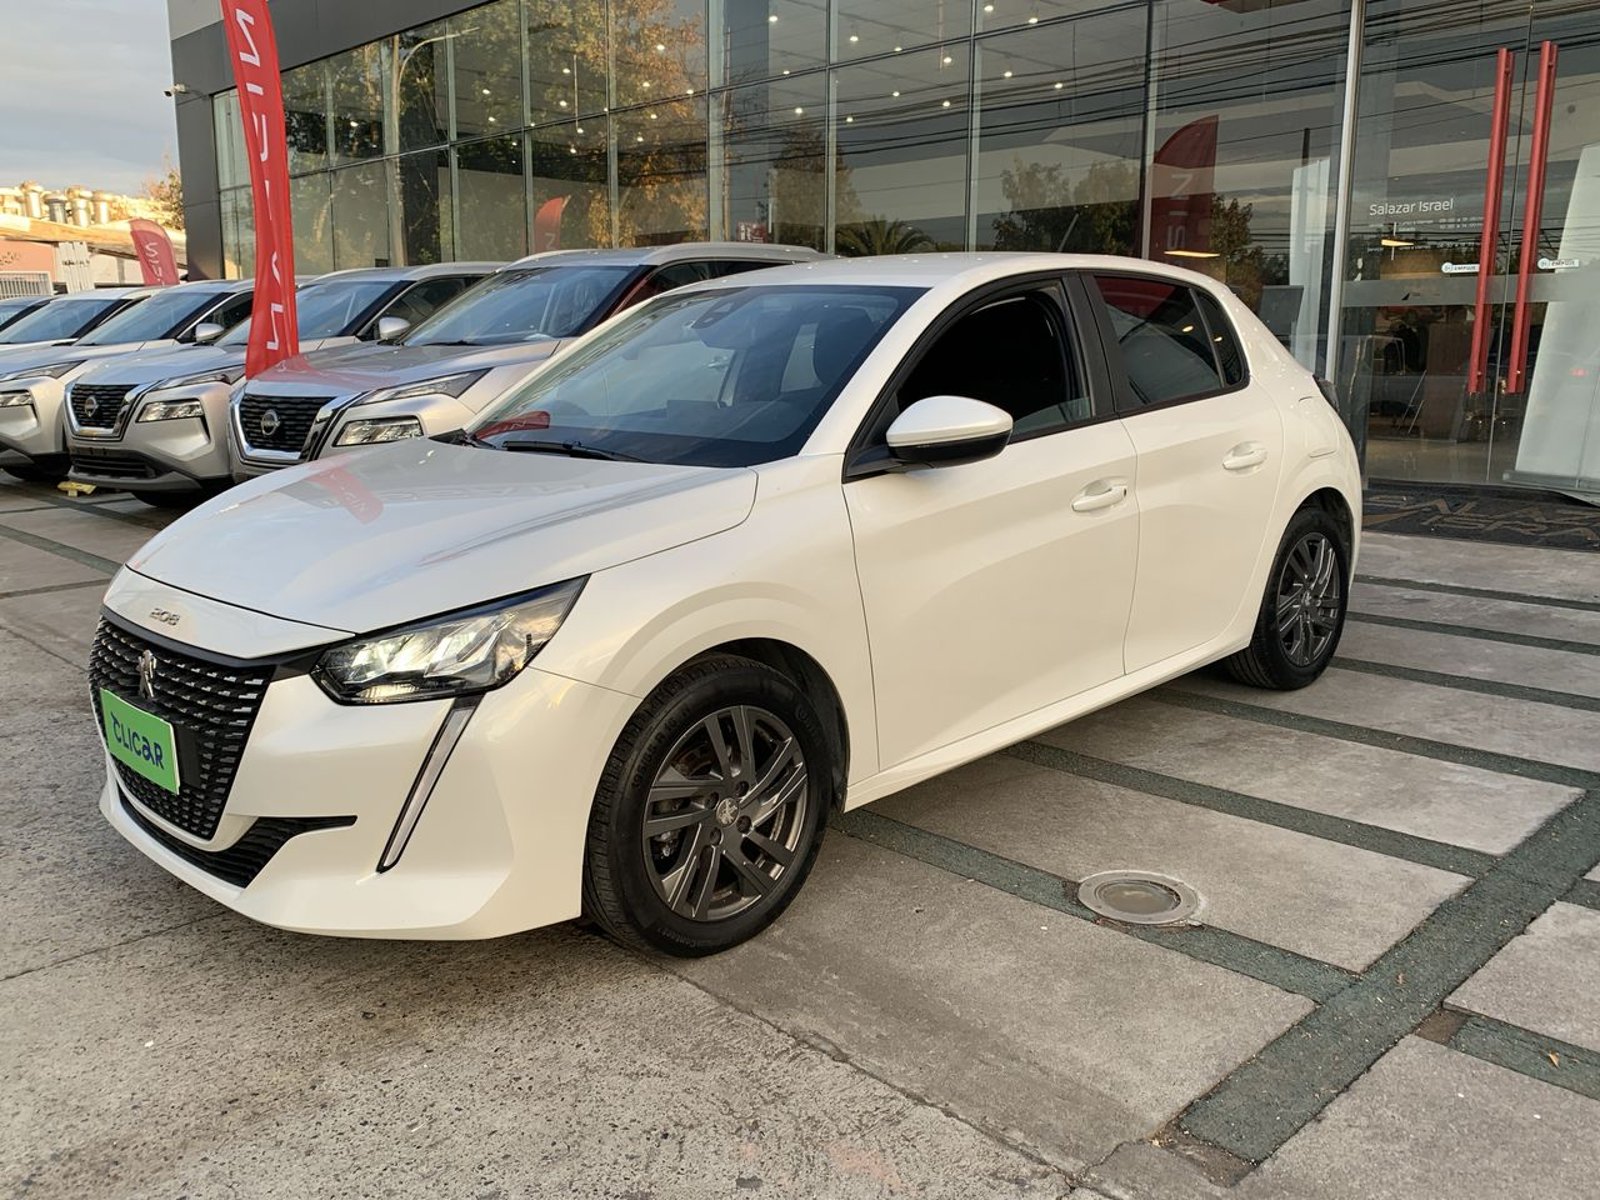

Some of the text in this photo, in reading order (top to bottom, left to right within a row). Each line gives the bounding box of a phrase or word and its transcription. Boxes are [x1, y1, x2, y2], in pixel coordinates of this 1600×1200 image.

[1369, 198, 1454, 216] Salazar Israel
[150, 607, 180, 626] 208
